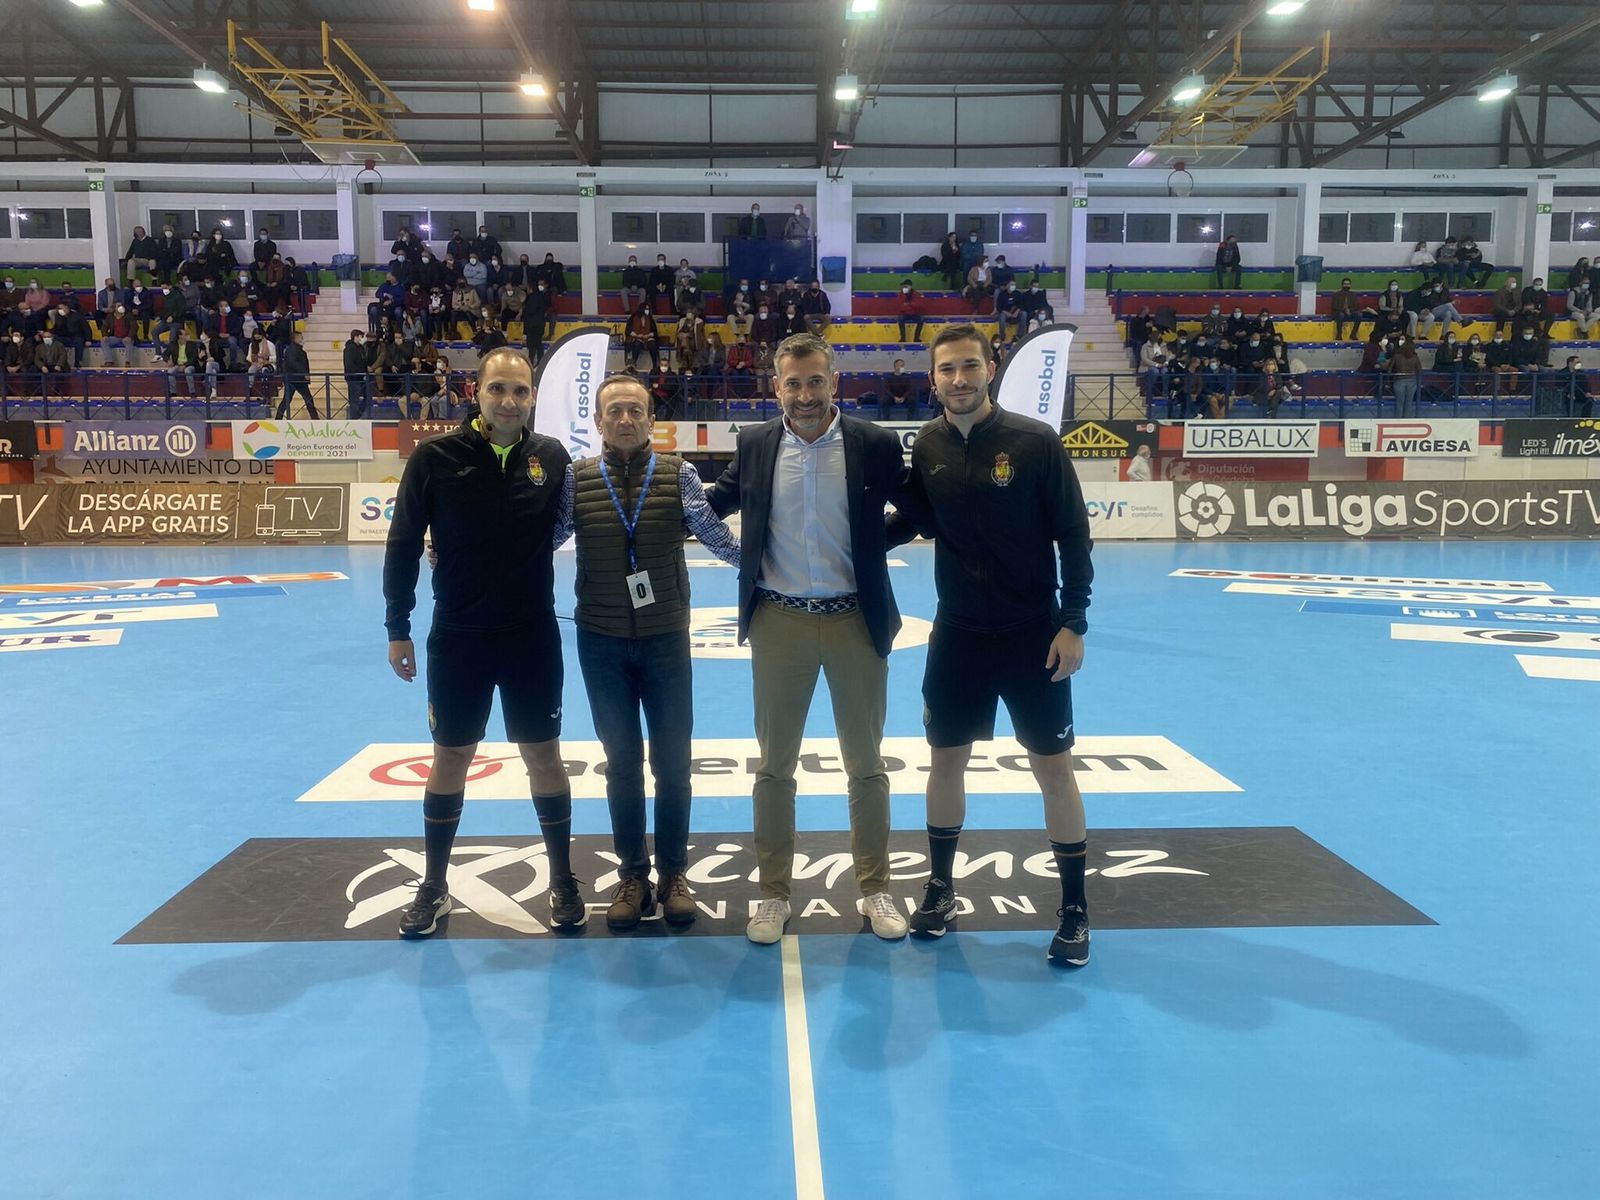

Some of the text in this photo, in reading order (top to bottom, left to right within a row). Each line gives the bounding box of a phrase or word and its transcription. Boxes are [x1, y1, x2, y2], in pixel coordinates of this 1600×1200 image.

[575, 353, 592, 418] asobal
[1038, 350, 1056, 414] asobal
[74, 430, 160, 452] Allianz
[287, 443, 312, 451] Región
[1192, 428, 1311, 448] URBALUX
[1071, 449, 1127, 457] MONSUR
[82, 459, 275, 475] AYUNTAMIENTO DE
[1198, 463, 1255, 475] Diputación
[79, 489, 222, 511] DESCÁRGATE
[284, 496, 323, 521] TV
[67, 515, 229, 533] LA APP GRATIS
